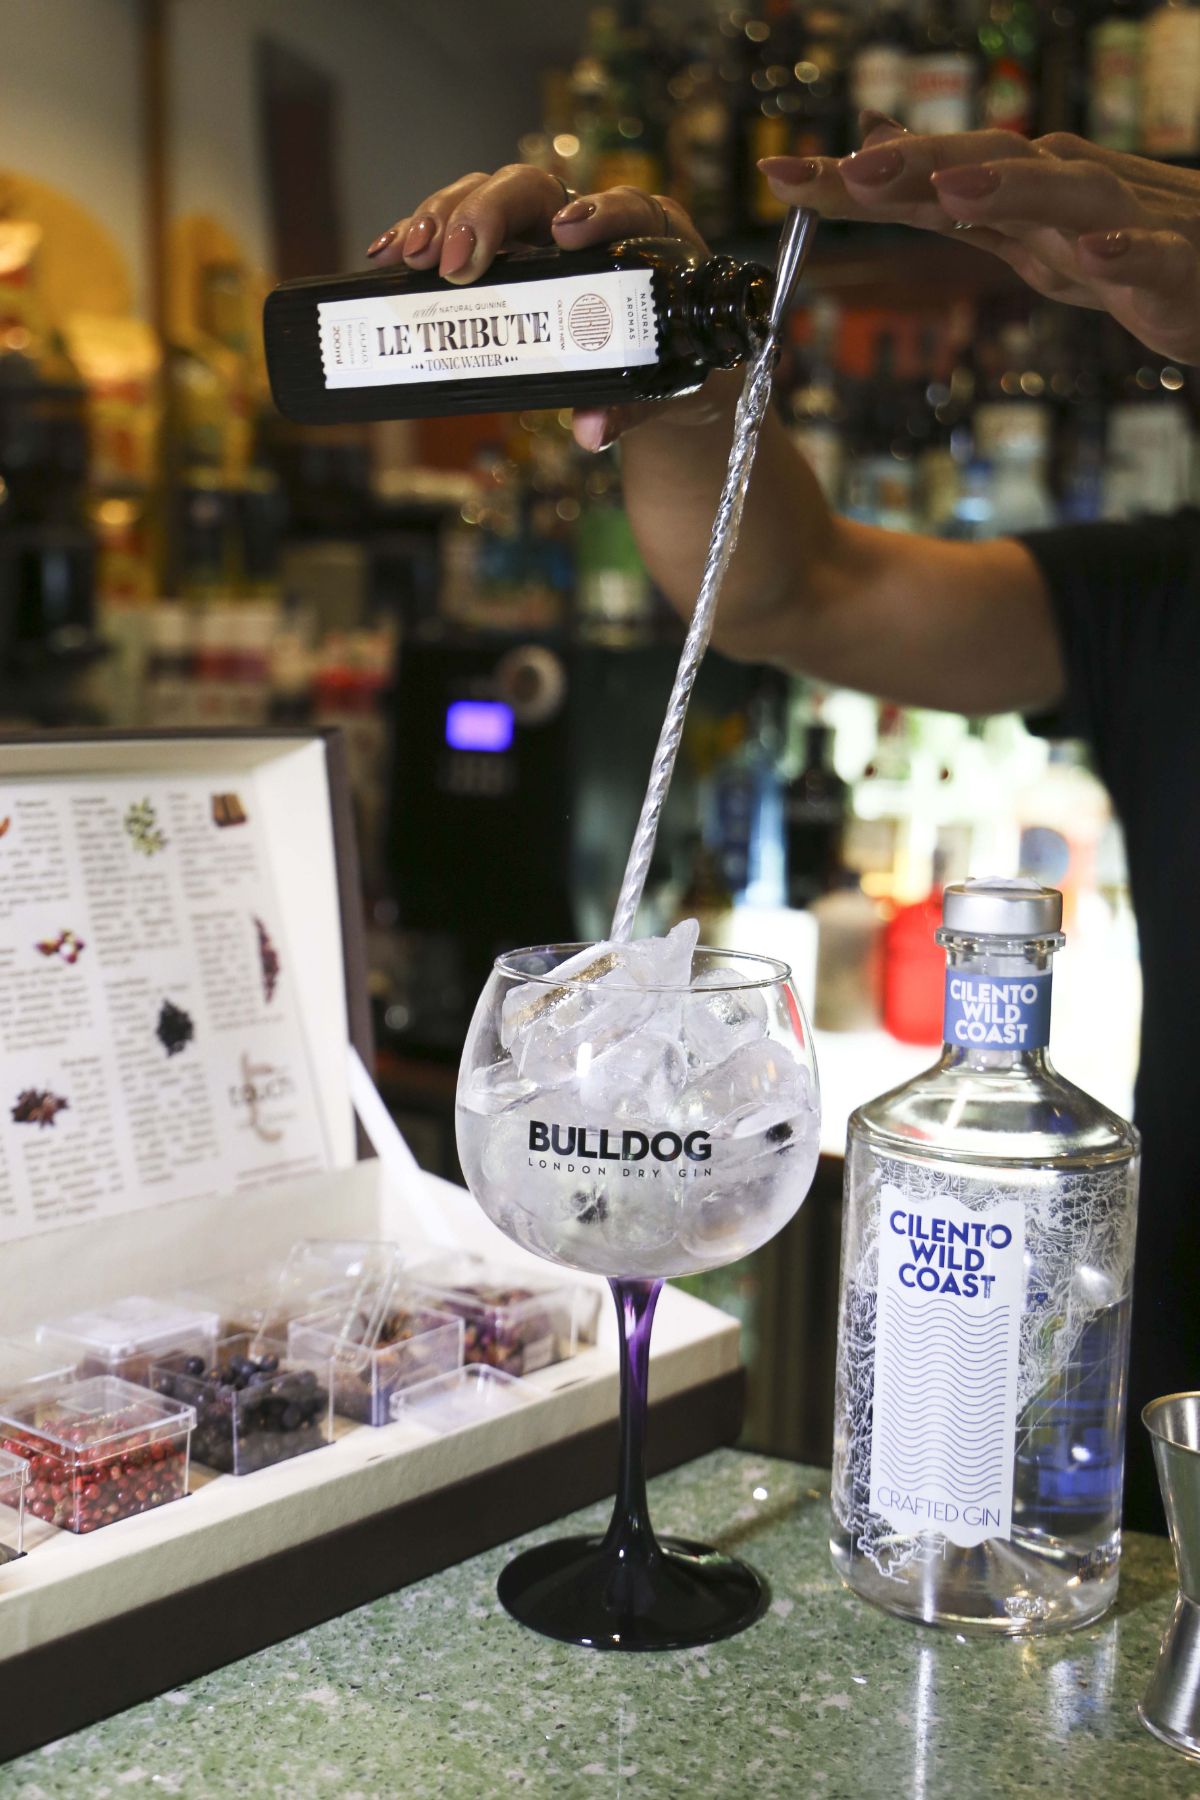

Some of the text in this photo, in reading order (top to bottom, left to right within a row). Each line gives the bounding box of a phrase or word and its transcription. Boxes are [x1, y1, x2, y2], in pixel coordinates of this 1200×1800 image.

[412, 300, 507, 319] with NATURAL QUININE
[570, 301, 612, 347] TRIBUTE
[627, 297, 636, 340] AROMAS
[640, 293, 649, 341] NATURAL
[376, 324, 412, 357] LE
[416, 311, 551, 353] TRIBUTE
[459, 353, 503, 370] WATER
[950, 979, 1038, 1005] CILENTO
[962, 1000, 1021, 1024] WILD
[954, 1019, 1029, 1044] COAST
[529, 1119, 712, 1162] BULLDOG
[528, 1157, 712, 1178] LONDON DRY GIN
[890, 1209, 1013, 1250] CILENTO
[909, 1239, 985, 1272] WILD
[898, 1262, 996, 1299] COAST
[877, 1486, 1000, 1527] CRAFTED GIN
